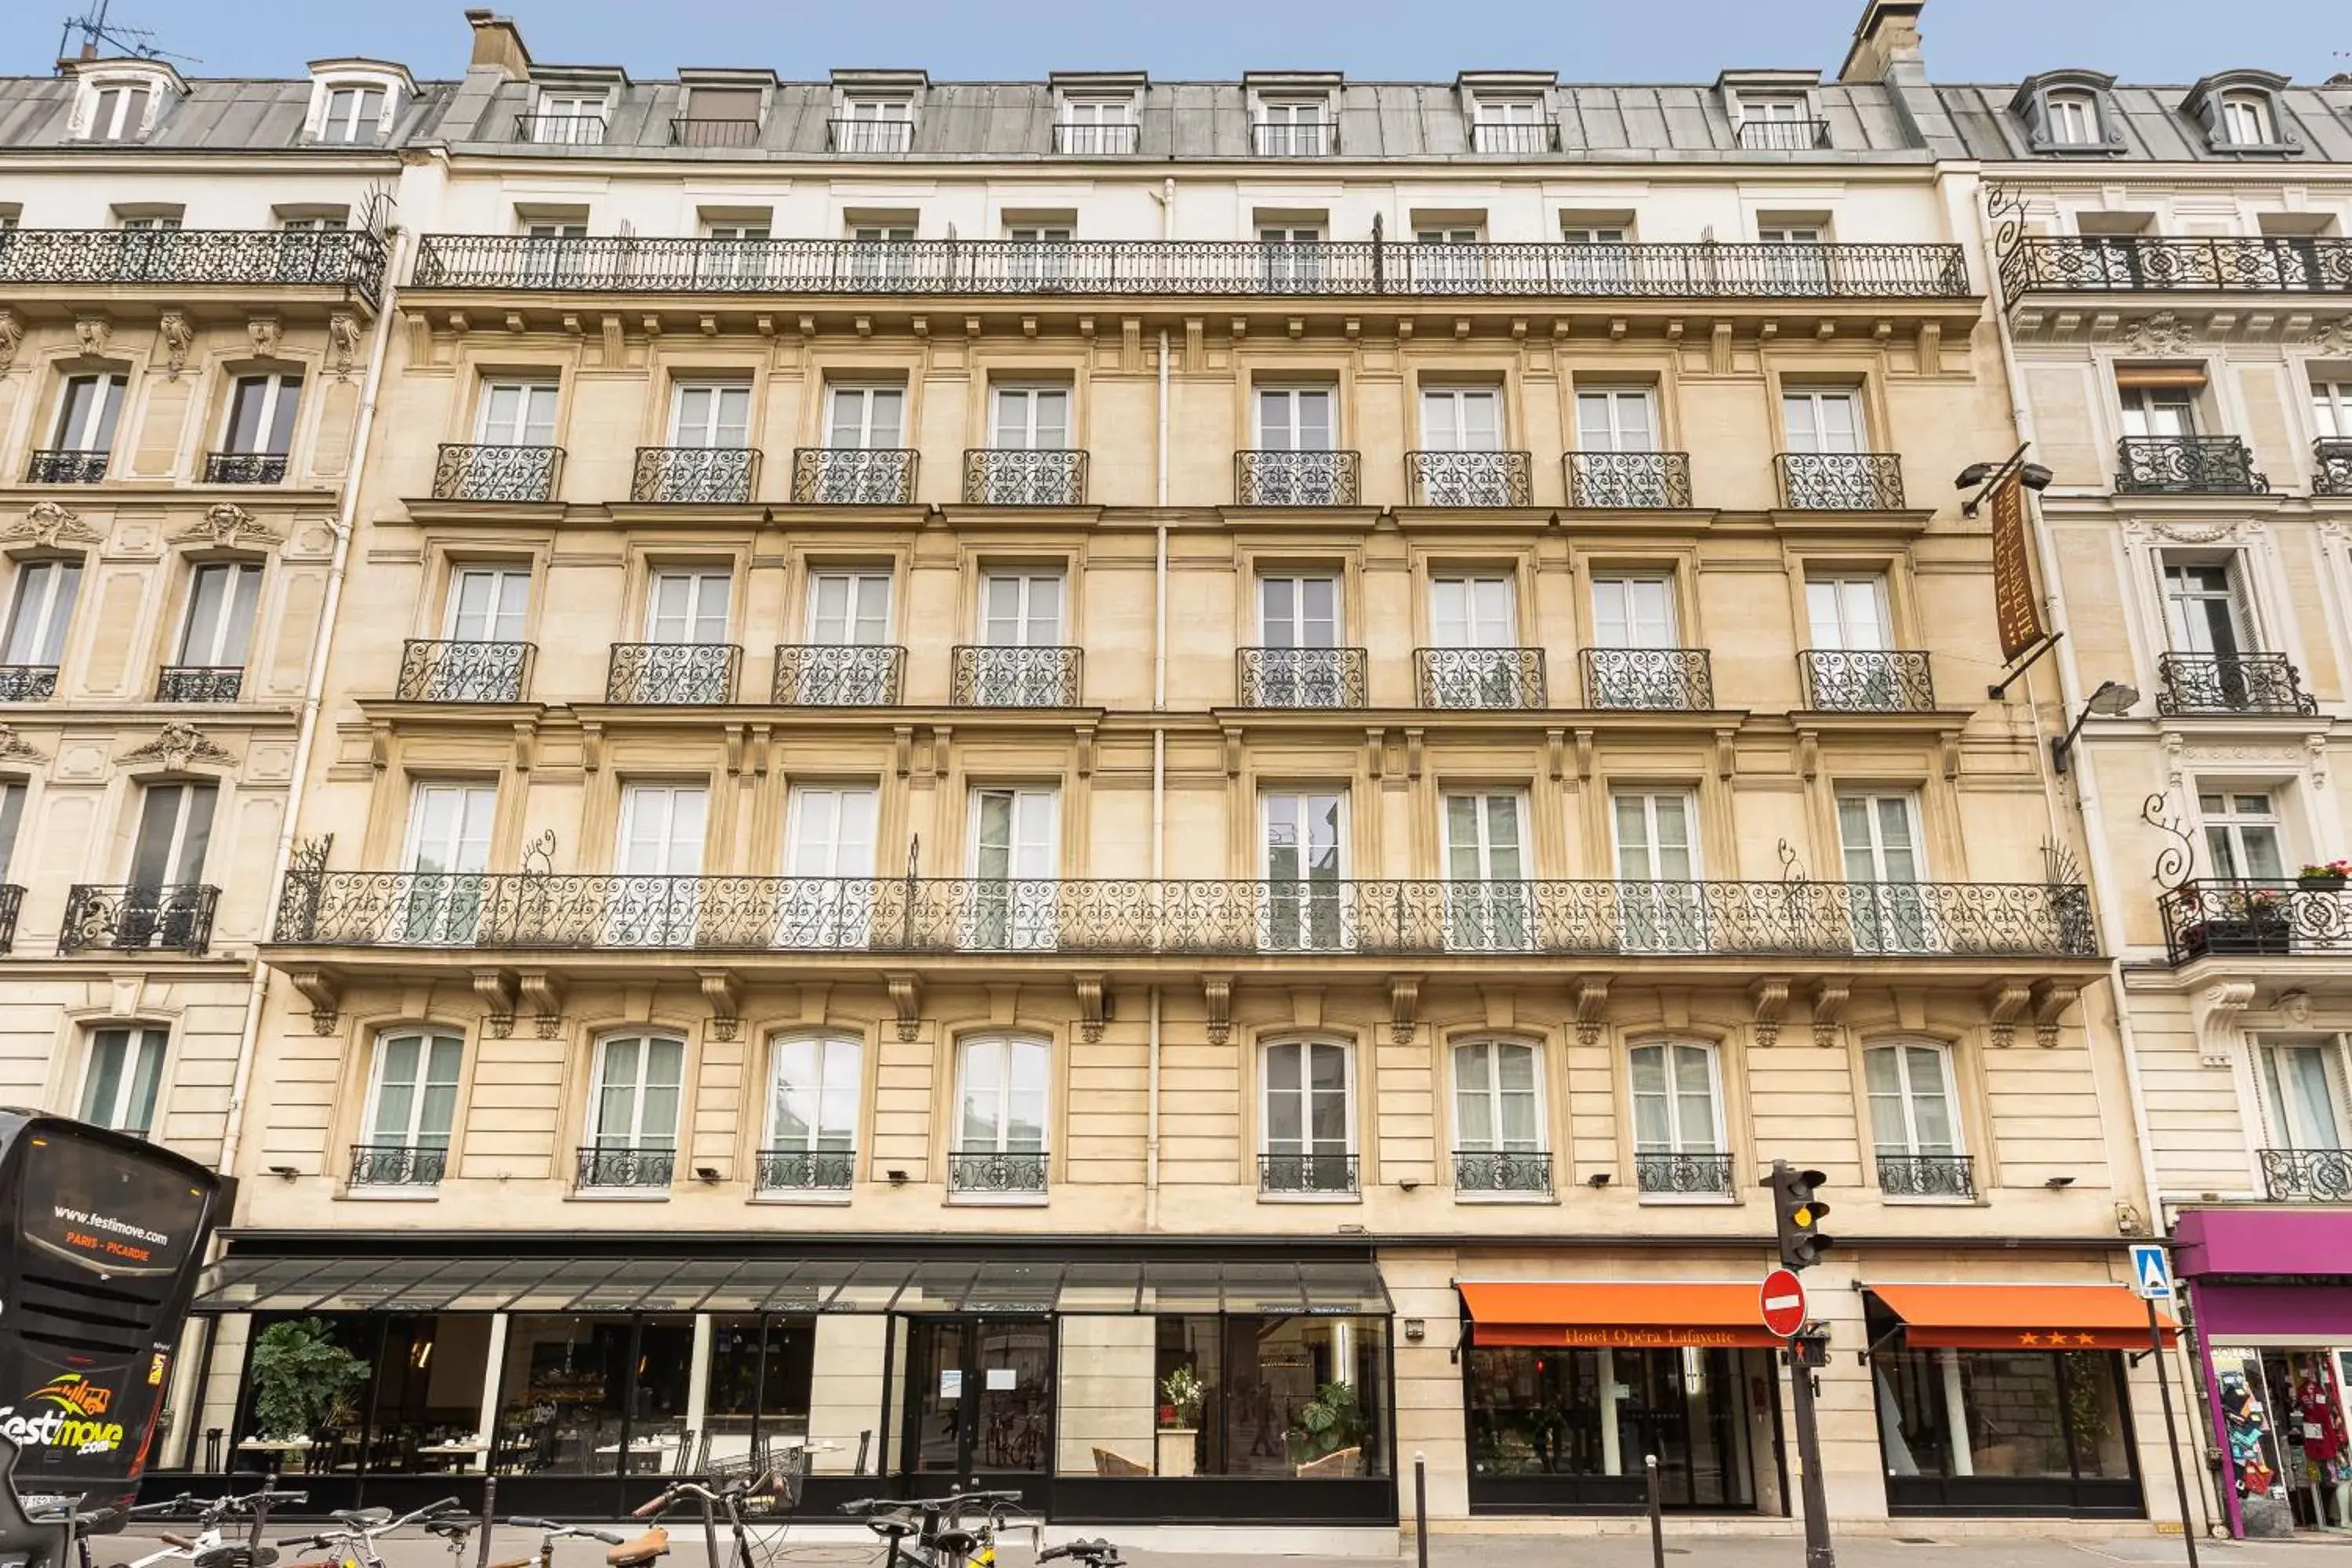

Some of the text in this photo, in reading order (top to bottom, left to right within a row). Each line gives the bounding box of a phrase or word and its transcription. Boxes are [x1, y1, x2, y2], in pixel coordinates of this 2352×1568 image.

[1996, 528, 2010, 619] HOTEL
[2008, 543, 2034, 641] LAFAYETTE
[54, 1206, 168, 1246] www.festimove.com
[66, 1232, 98, 1249] PARIS
[106, 1241, 151, 1261] PICARDIE
[1566, 1329, 1735, 1348] Hotel Opéra Lafayette
[77, 1440, 109, 1456] .com
